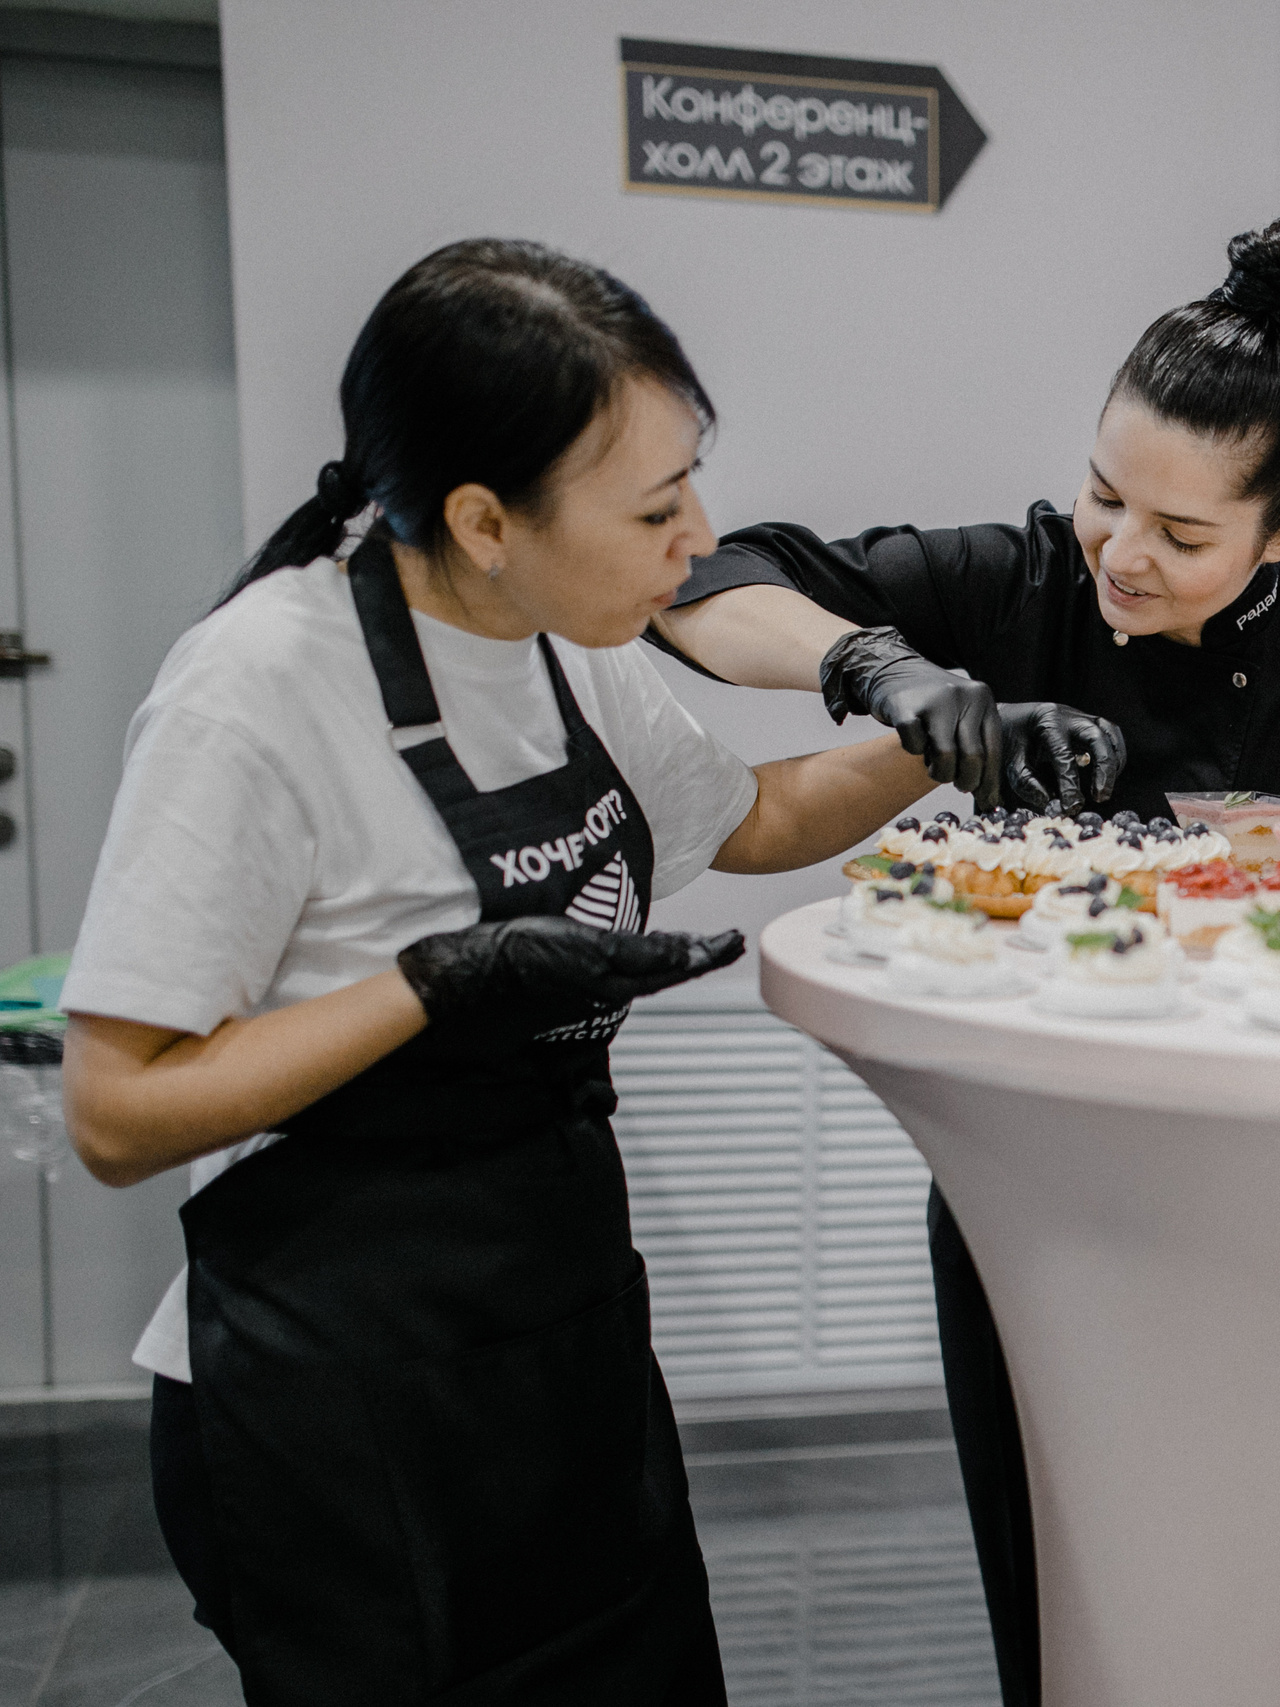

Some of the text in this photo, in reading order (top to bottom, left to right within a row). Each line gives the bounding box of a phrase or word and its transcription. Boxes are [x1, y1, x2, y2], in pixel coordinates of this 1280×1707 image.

[642, 74, 929, 147] Конференц-
[760, 140, 791, 186] 2
[798, 152, 915, 196] этаж
[1236, 575, 1279, 631] Рада
[489, 830, 586, 888] ХОЧЕ
